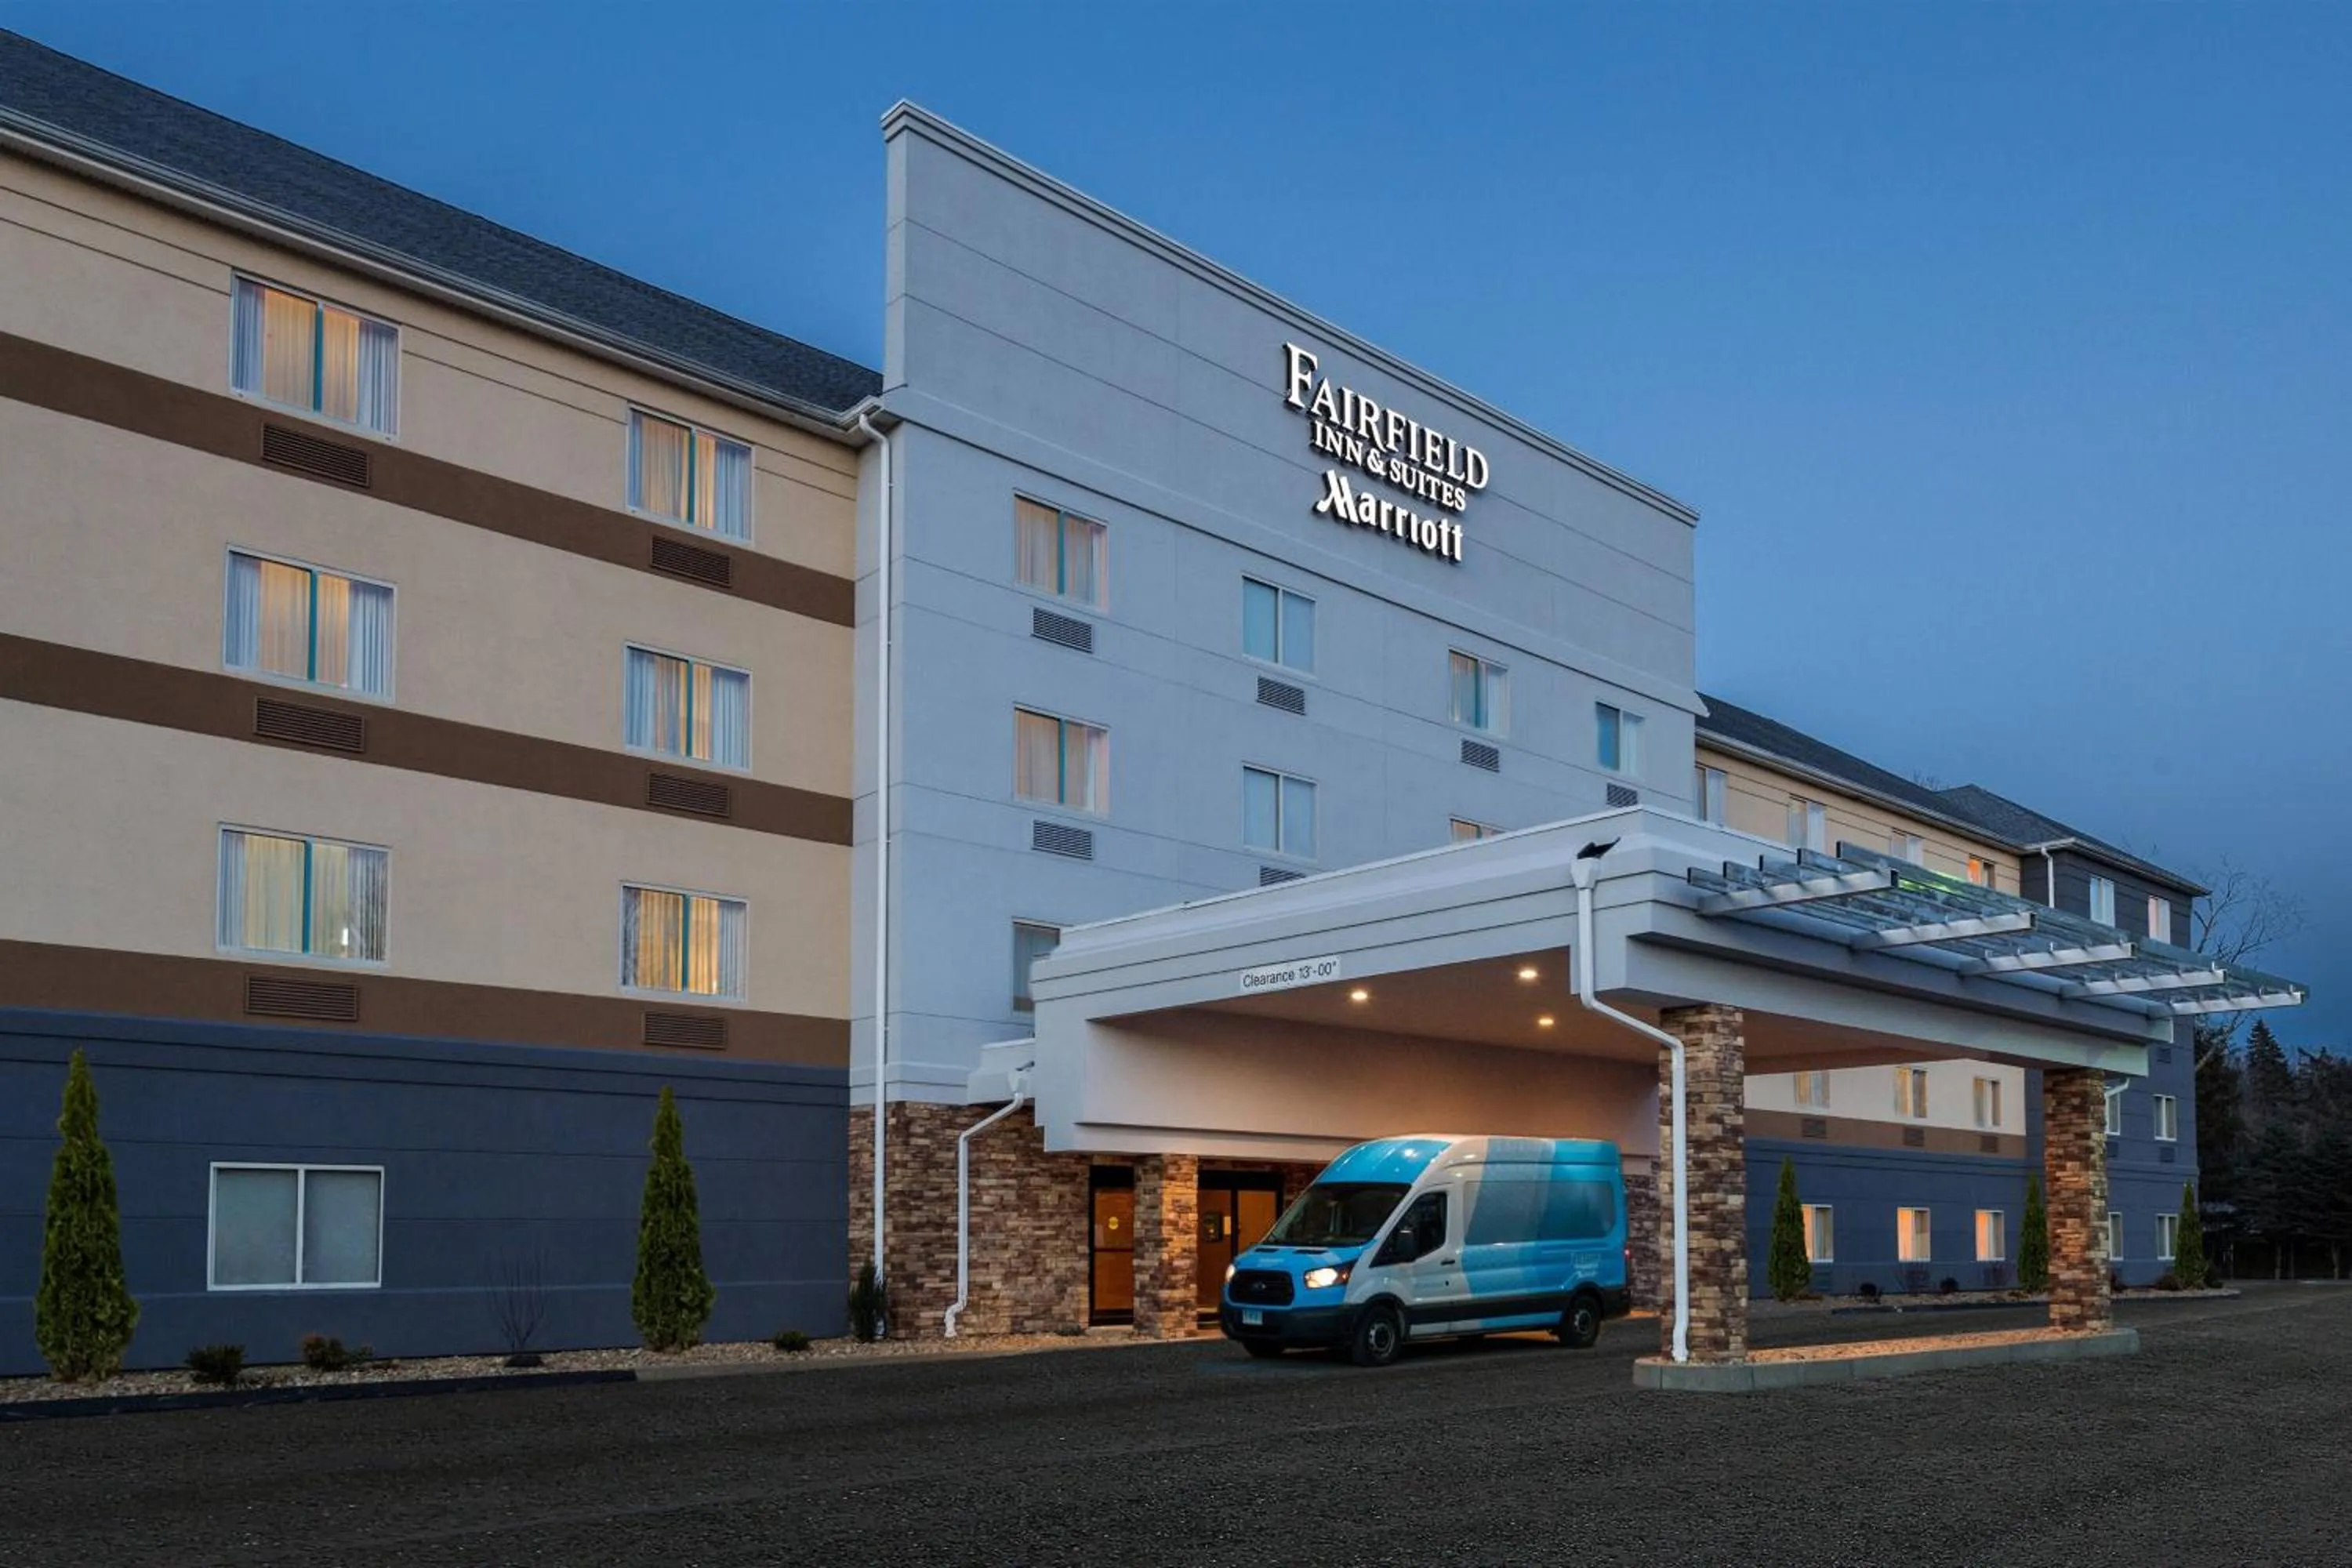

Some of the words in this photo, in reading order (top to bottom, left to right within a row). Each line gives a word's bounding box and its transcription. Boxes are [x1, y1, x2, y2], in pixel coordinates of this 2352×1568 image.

[1286, 342, 1489, 489] FAIRFIELD
[1314, 419, 1363, 467] INN
[1367, 448, 1387, 477] &
[1390, 457, 1467, 513] SUITES
[1316, 469, 1464, 561] Marriott
[1243, 970, 1294, 988] Clearance
